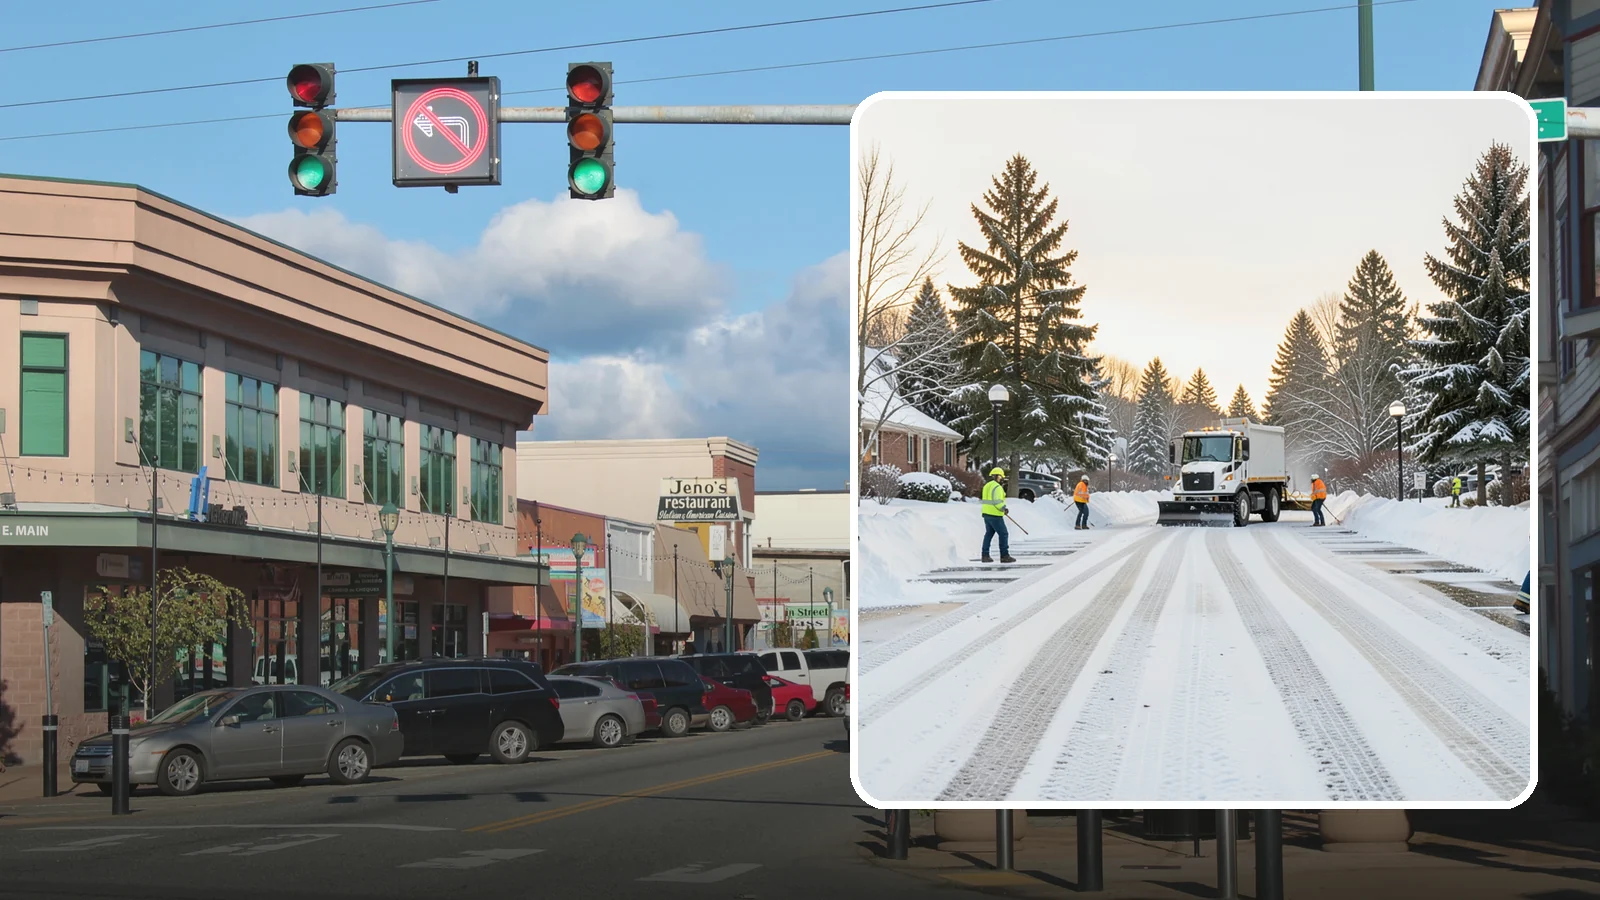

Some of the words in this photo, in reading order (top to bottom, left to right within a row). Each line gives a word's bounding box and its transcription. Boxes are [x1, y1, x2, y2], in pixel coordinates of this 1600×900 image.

[670, 480, 727, 495] Jeno's
[665, 496, 731, 509] restaurant
[658, 510, 681, 519] Italian
[686, 510, 714, 519] American
[715, 510, 738, 519] Cuisine
[2, 525, 13, 536] E.
[15, 525, 49, 536] MAIN
[797, 607, 828, 617] Street
